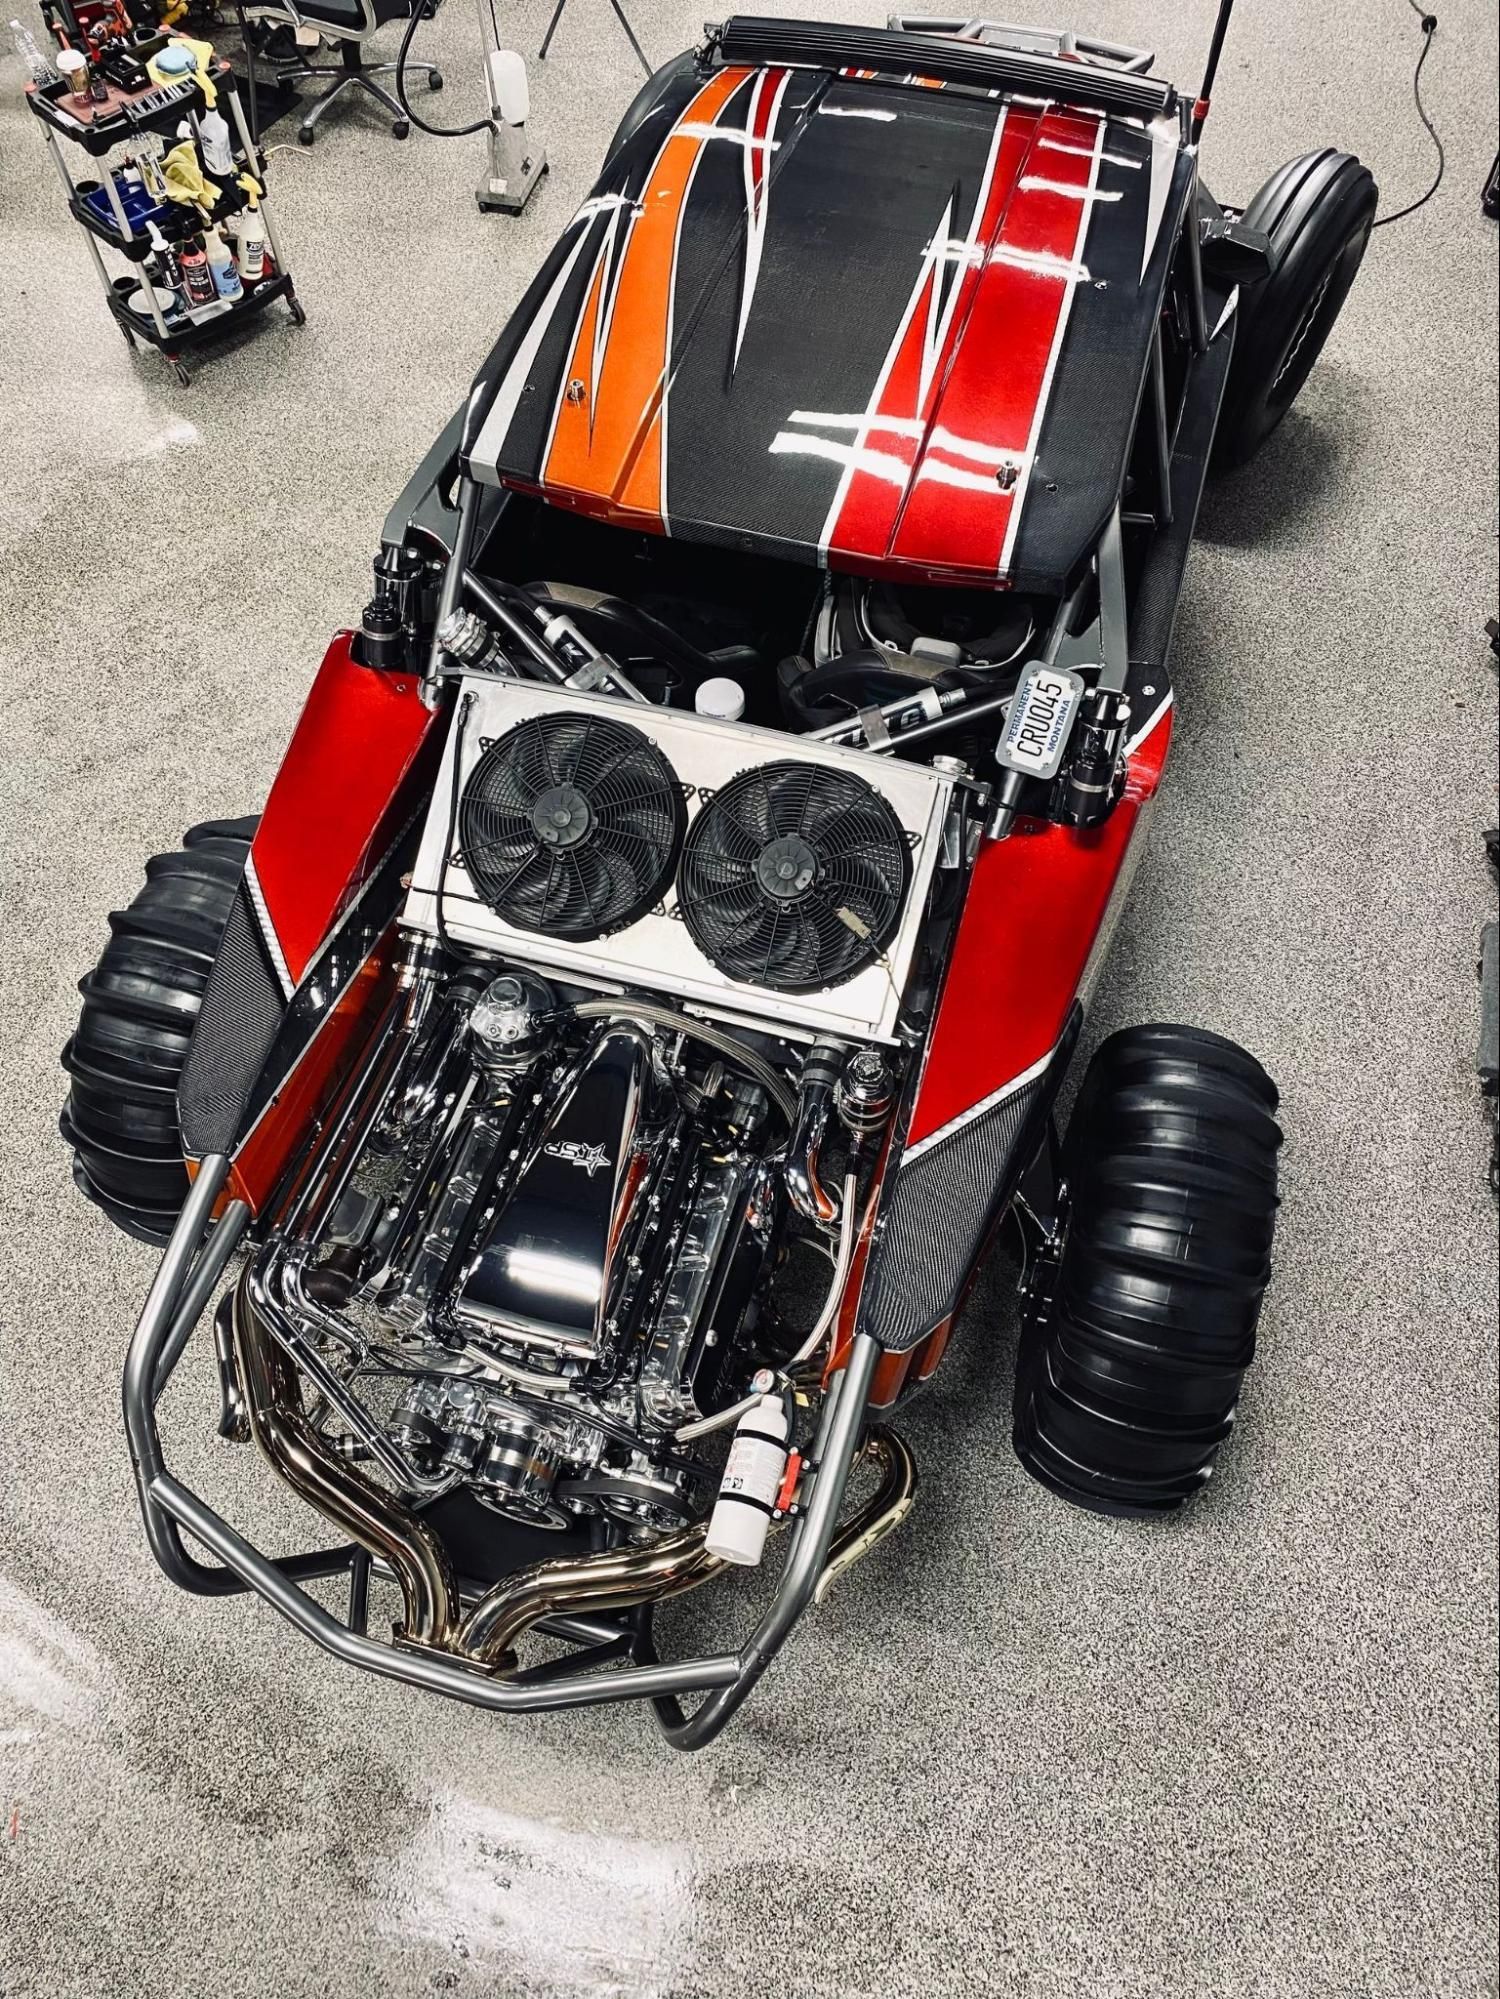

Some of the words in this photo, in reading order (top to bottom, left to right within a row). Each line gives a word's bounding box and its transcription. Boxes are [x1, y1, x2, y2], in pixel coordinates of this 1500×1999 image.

[1006, 680, 1034, 744] PERMANENT
[1016, 679, 1062, 757] CRU045
[1046, 699, 1071, 752] MONTANA
